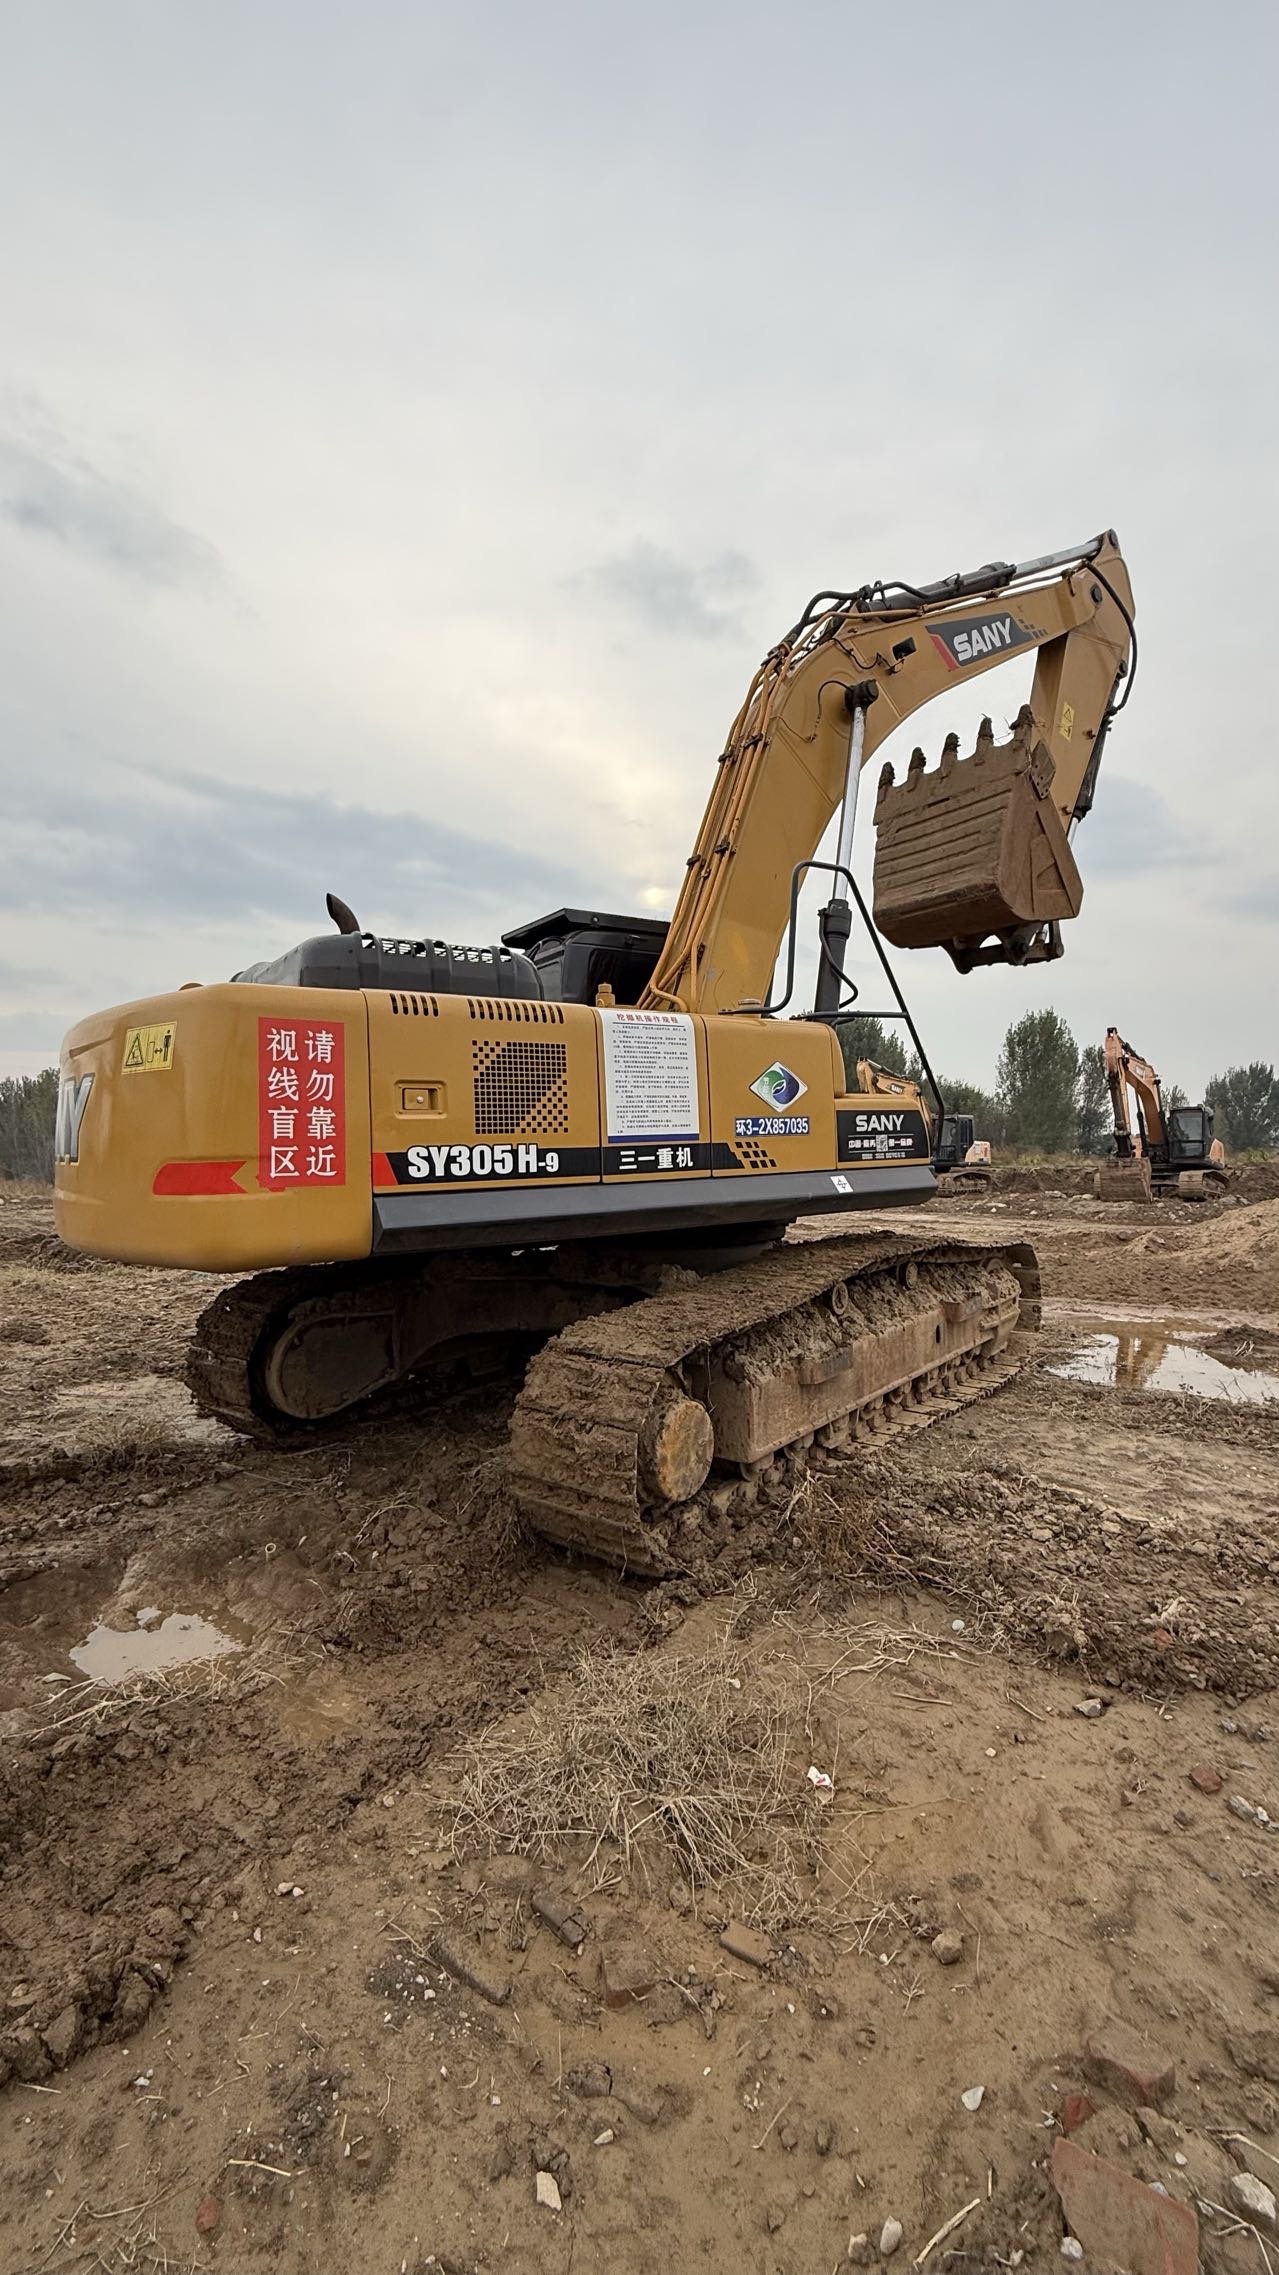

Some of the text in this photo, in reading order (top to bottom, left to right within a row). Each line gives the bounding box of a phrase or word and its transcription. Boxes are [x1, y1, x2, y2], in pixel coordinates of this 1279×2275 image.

[952, 617, 1012, 662] SANY
[266, 1027, 300, 1179] 视线盲区
[304, 1030, 338, 1178] 请勿靠近
[736, 1118, 809, 1135] 环3-2X857035
[855, 1114, 904, 1132] SANY
[406, 1144, 559, 1178] SY305H-9
[619, 1146, 694, 1170] 三一重机
